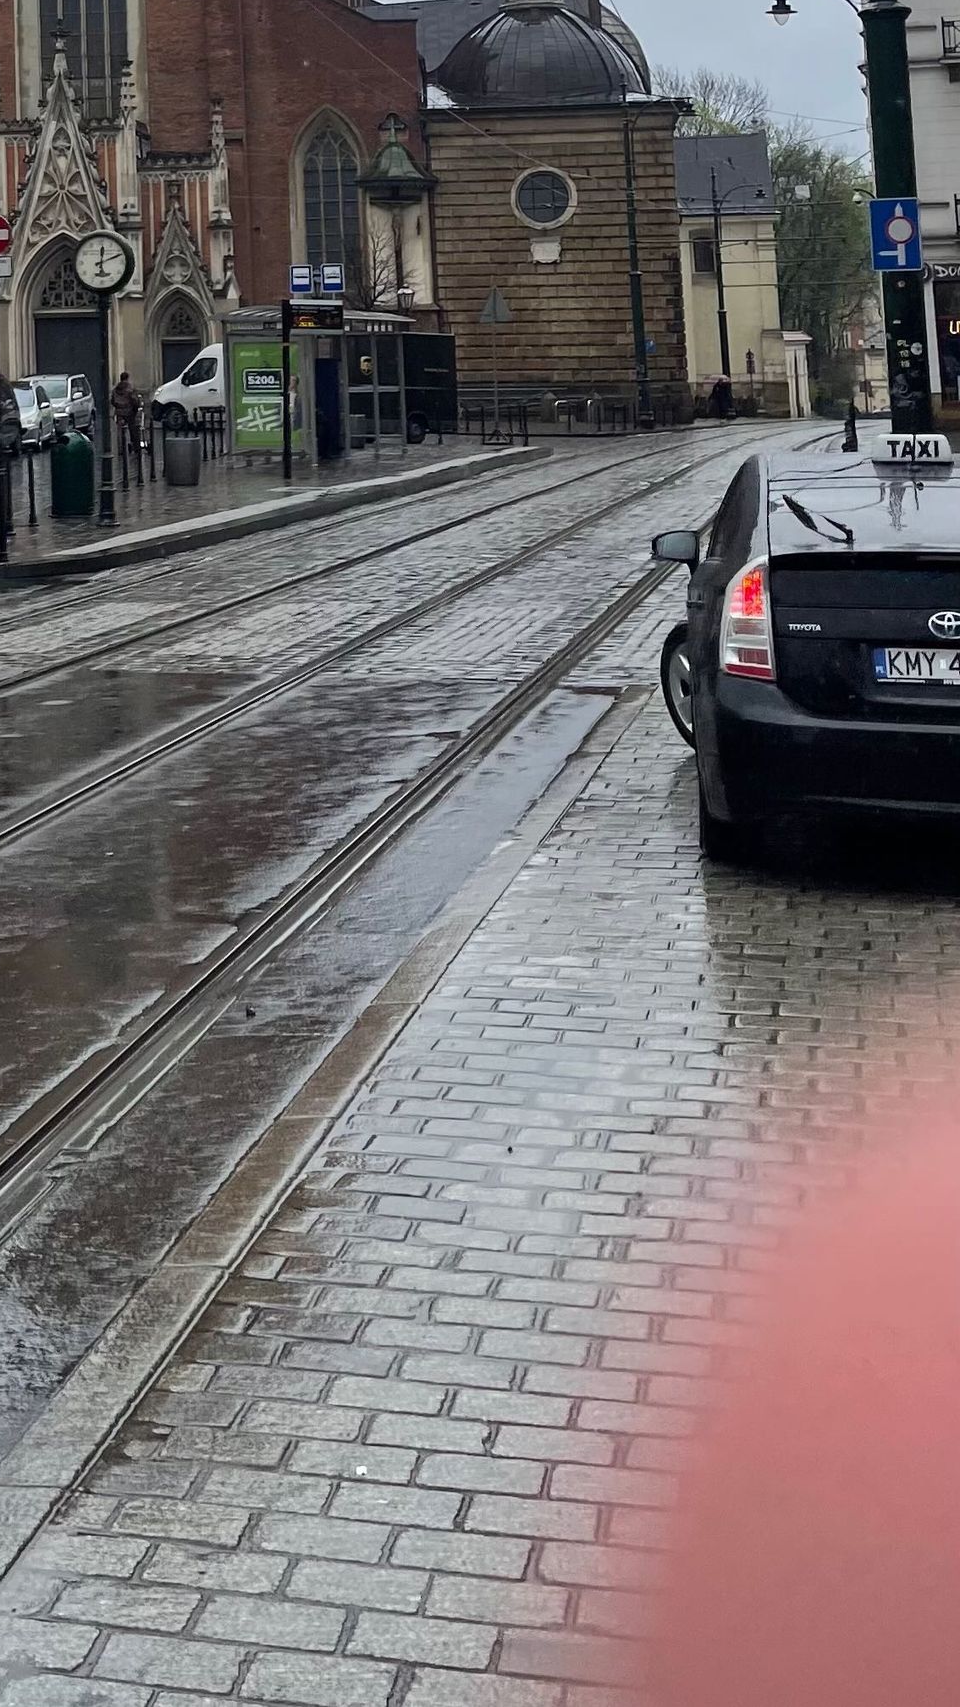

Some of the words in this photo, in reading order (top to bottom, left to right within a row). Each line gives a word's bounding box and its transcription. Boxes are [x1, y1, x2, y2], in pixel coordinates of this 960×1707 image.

[247, 375, 275, 385] 5200
[886, 440, 940, 459] TAXI
[788, 623, 822, 632] TOYOTA
[888, 650, 936, 676] KMY
